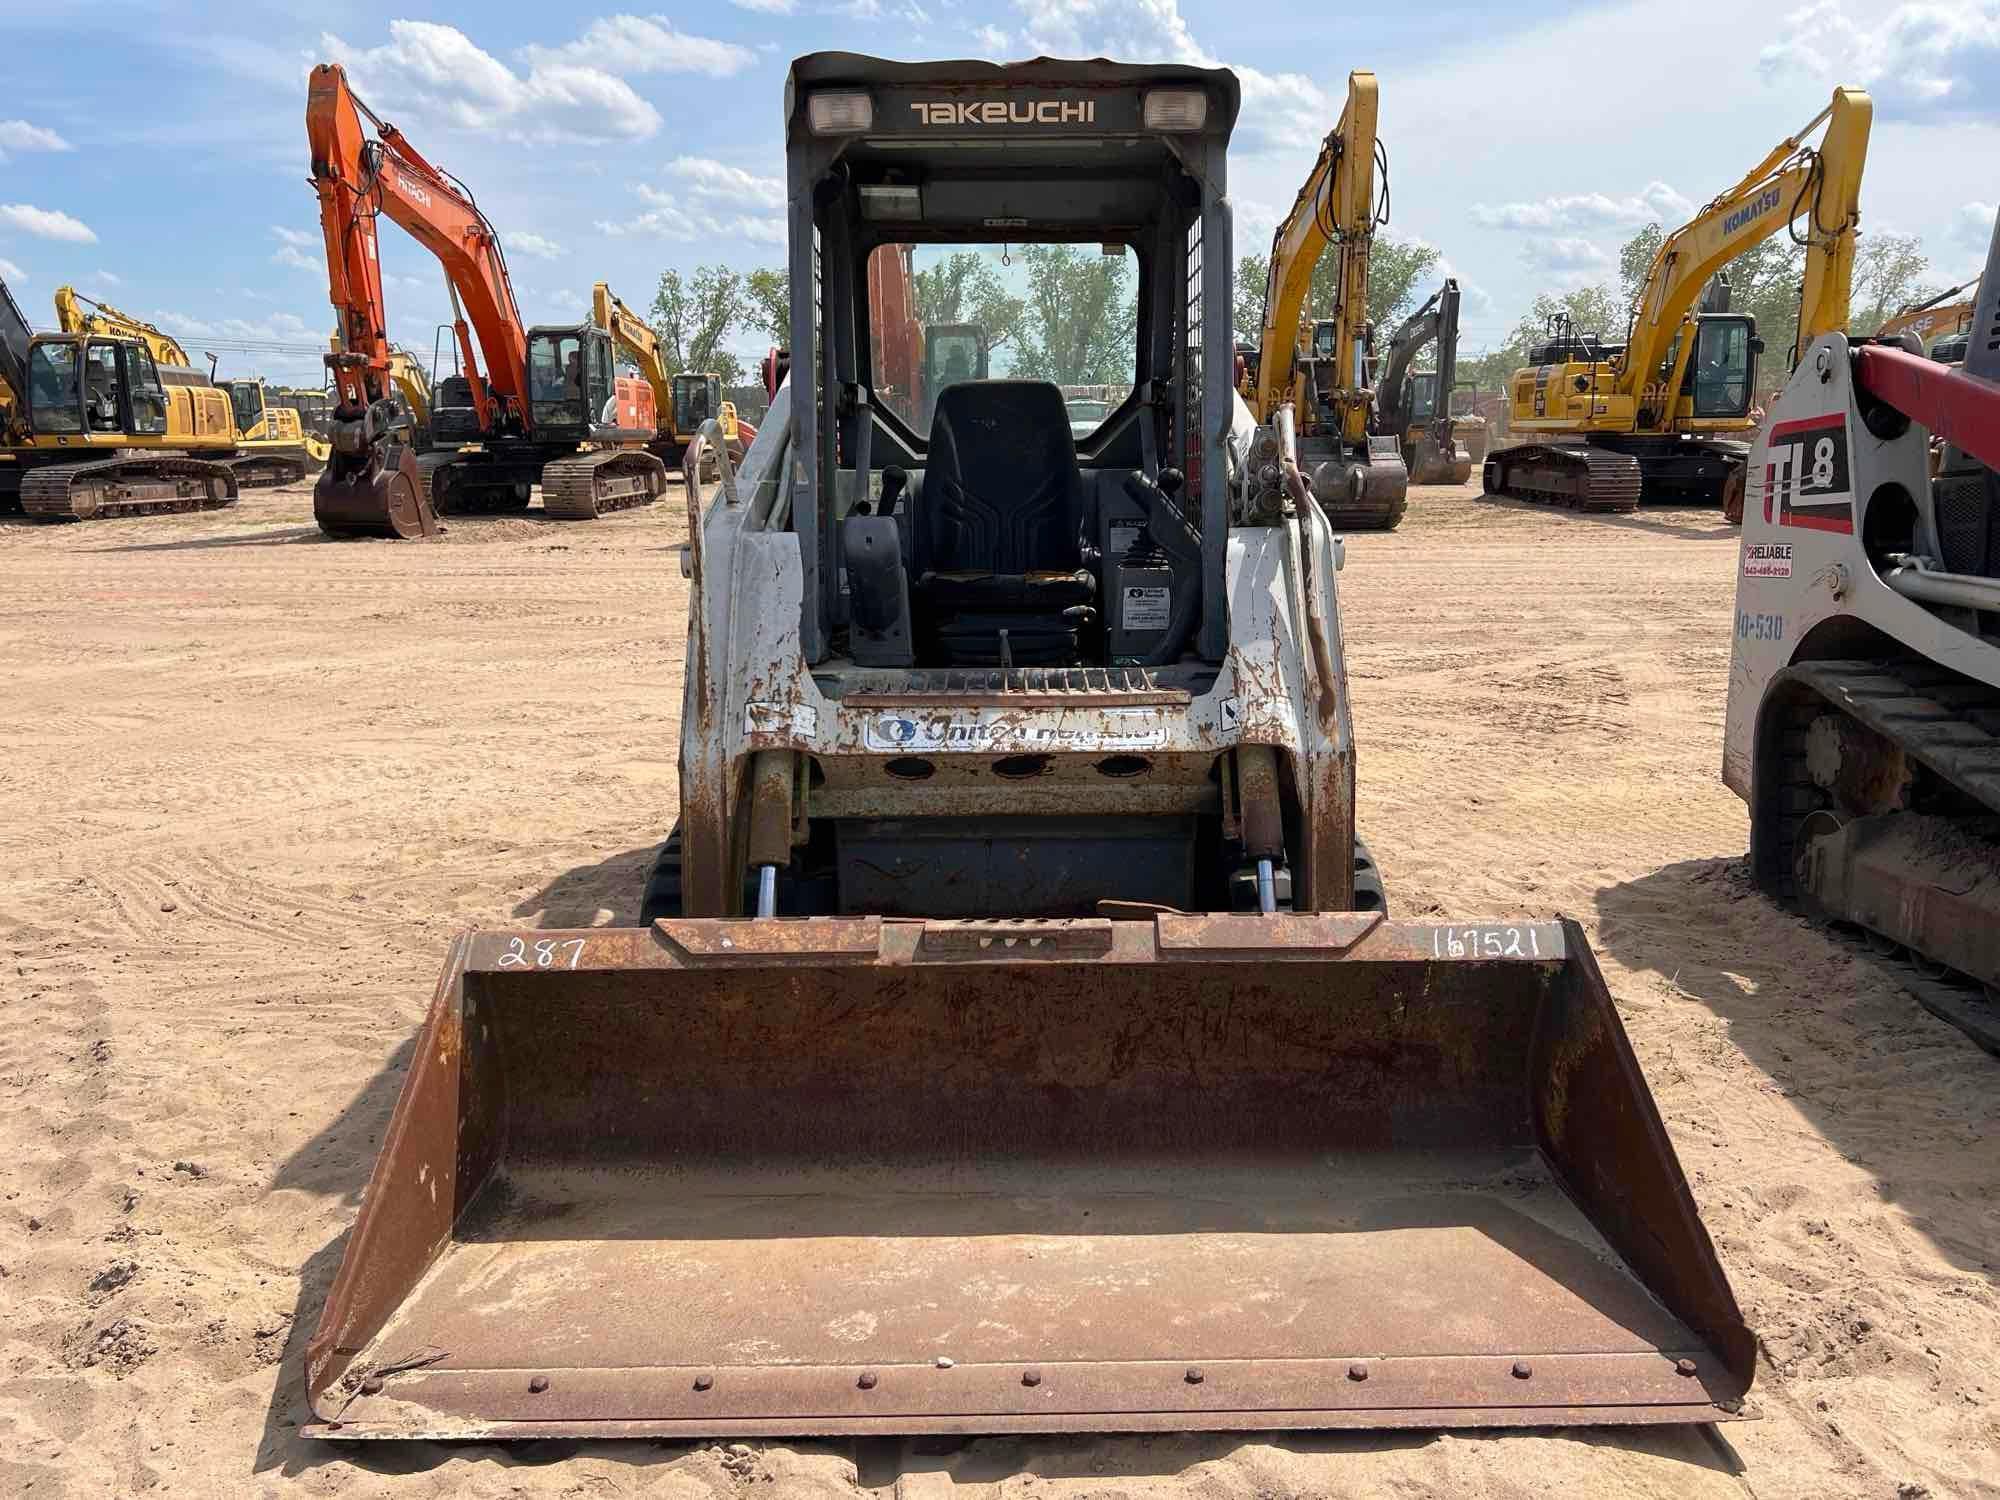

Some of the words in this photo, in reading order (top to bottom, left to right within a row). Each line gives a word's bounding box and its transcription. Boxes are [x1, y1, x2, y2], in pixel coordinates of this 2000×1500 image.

[398, 174, 432, 208] HITACHI
[1722, 188, 1781, 236] KOMATSU
[1767, 437, 1852, 526] TL8
[1751, 546, 1792, 560] RELIABLE
[498, 937, 586, 970] 287
[1433, 928, 1540, 958] 167521
